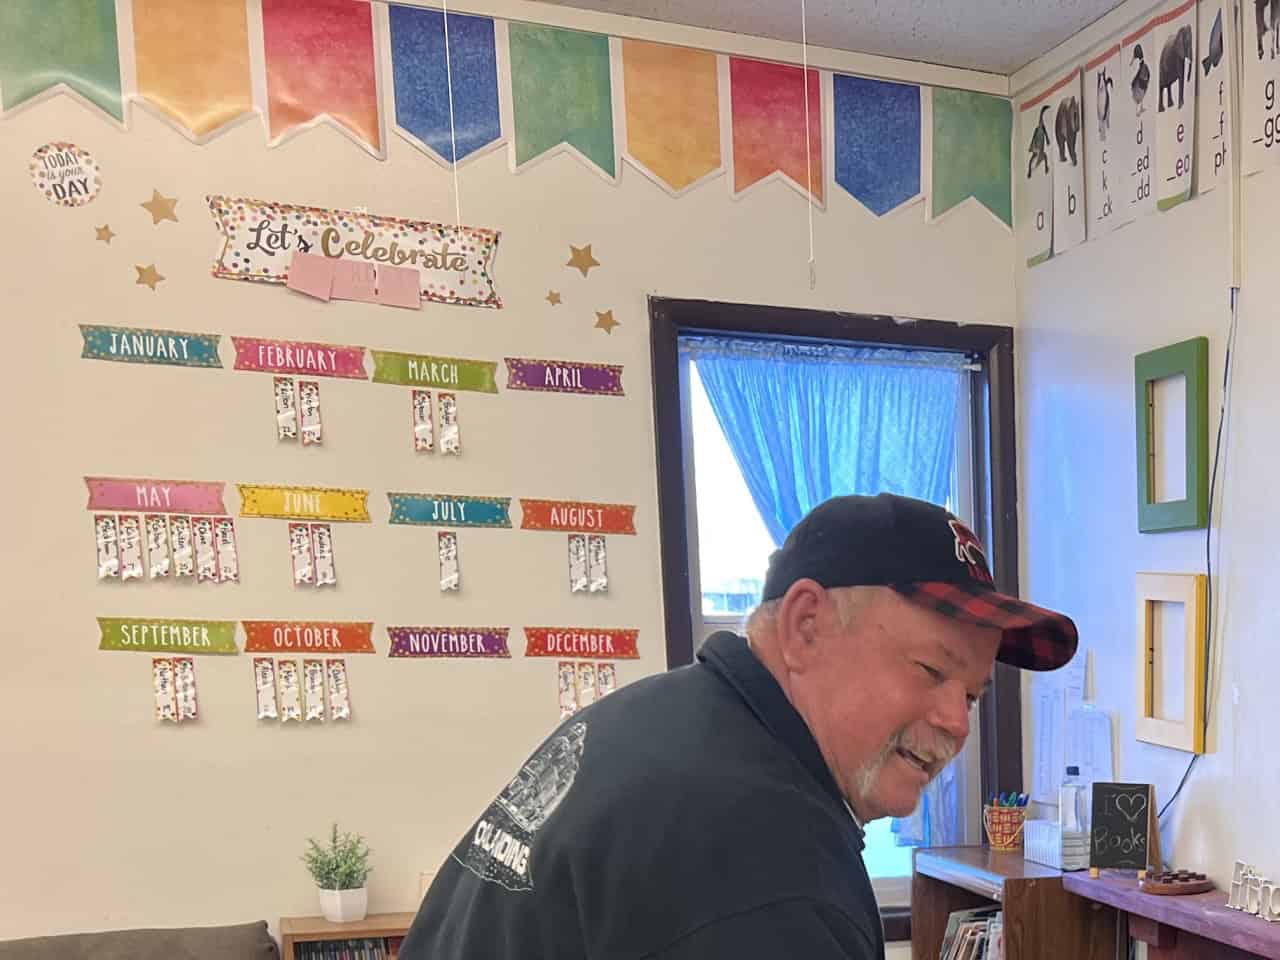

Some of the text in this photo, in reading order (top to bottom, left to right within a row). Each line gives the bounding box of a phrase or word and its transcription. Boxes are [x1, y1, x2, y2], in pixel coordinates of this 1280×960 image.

[1265, 79, 1275, 111] g
[1136, 120, 1143, 145] d
[1176, 123, 1185, 142] e
[41, 151, 81, 170] TODAY
[47, 165, 83, 184] is your
[52, 178, 90, 200] DAY
[1067, 185, 1076, 215] b
[246, 219, 469, 272] Let's Celebrate
[109, 333, 189, 360] JANUARY
[258, 345, 337, 370] FEBRUARY
[408, 359, 459, 384] MARCH
[545, 367, 583, 388] APRIL
[136, 486, 171, 507] MAY
[283, 493, 321, 513] JUNE
[431, 501, 465, 521] JULY
[550, 508, 604, 528] AUGUST
[120, 624, 211, 648] SEPTEMBER
[273, 627, 342, 648] OCTOBER
[408, 633, 486, 653] NOVEMBER
[546, 632, 615, 653] DECEMBER
